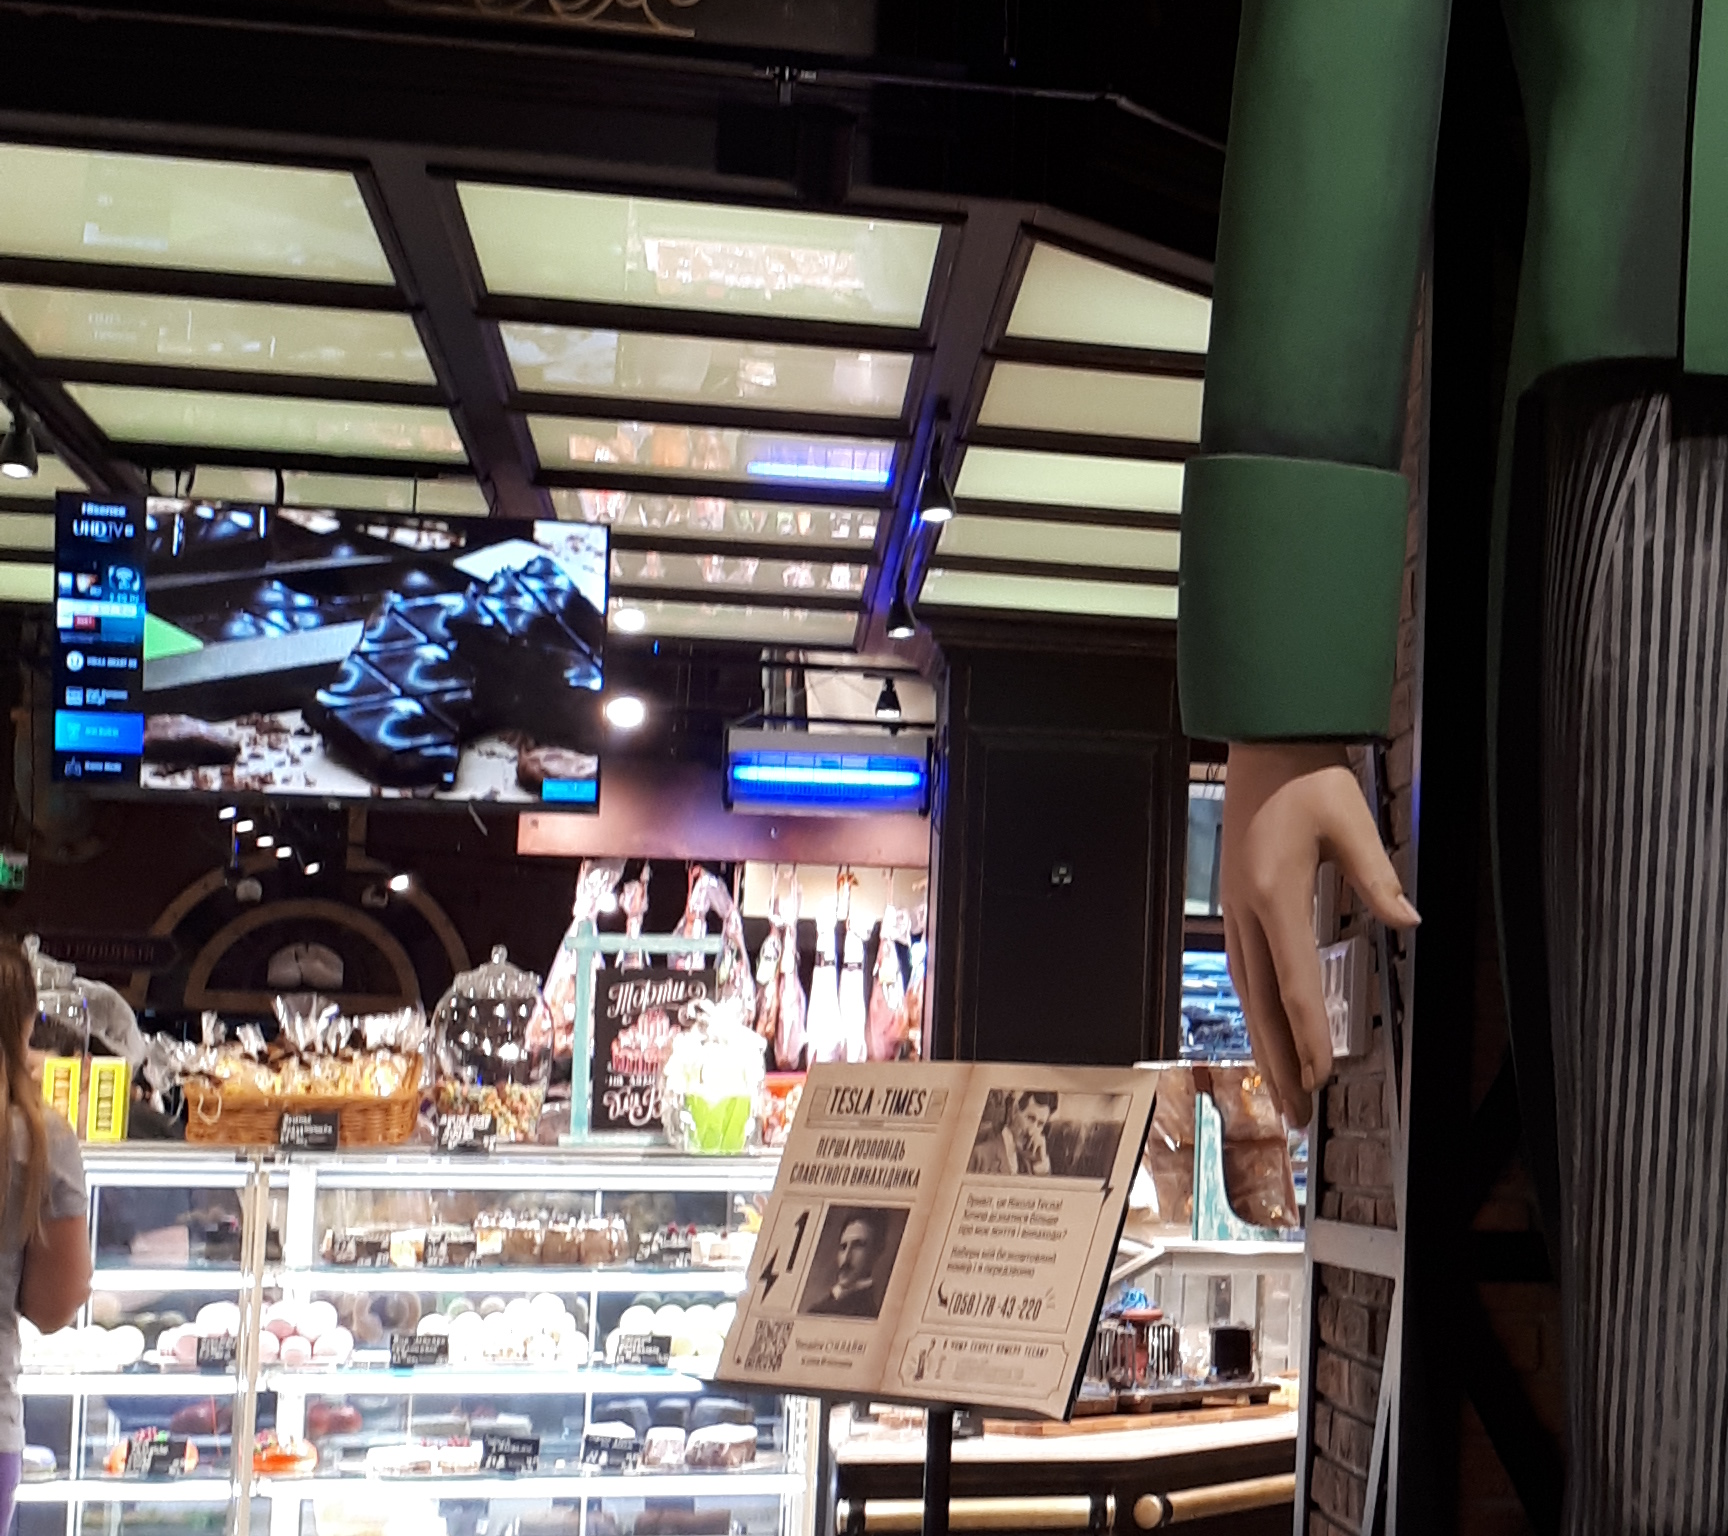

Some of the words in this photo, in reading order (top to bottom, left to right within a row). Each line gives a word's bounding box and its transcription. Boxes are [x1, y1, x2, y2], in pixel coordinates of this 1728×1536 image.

[830, 1085, 876, 1116] TESLA
[881, 1087, 927, 1118] TIMES
[816, 1135, 850, 1158] ПЕРША
[850, 1137, 906, 1162] РОЗПОВІДЬ
[789, 1162, 851, 1187] СЛАВЕТНОГО
[850, 1165, 921, 1190] ВИНАХІДНИКА
[784, 1210, 809, 1275] 1
